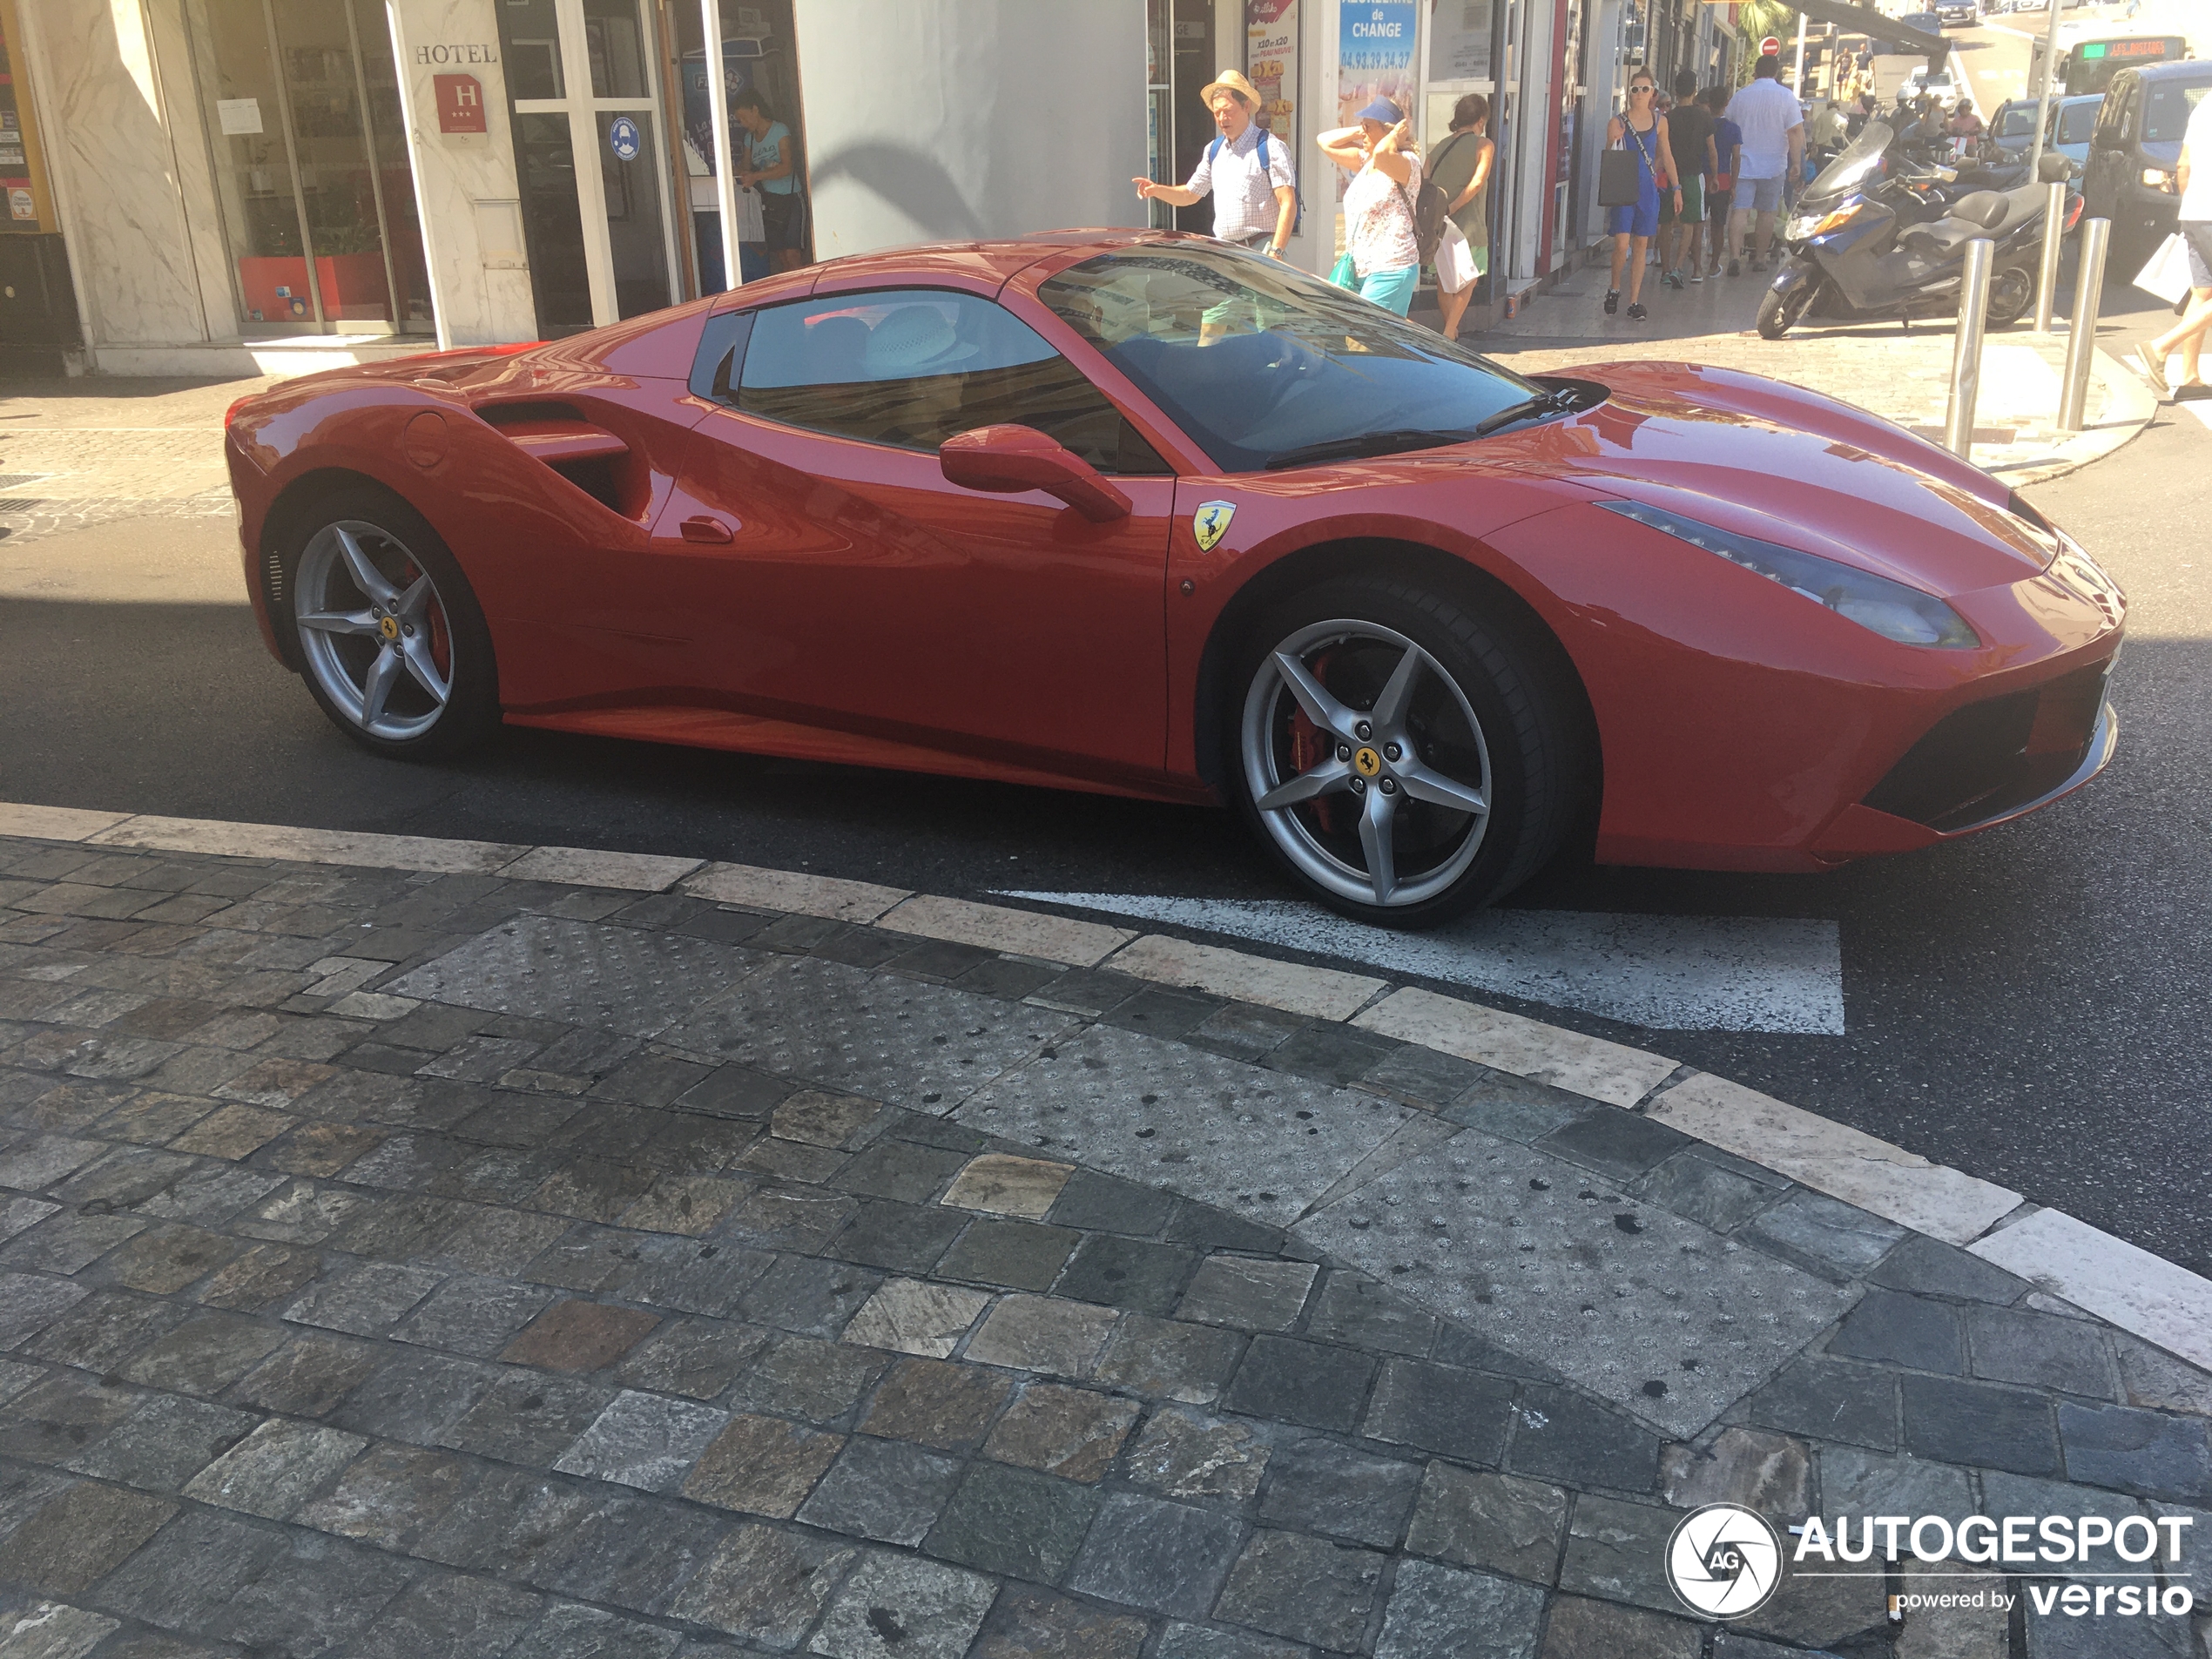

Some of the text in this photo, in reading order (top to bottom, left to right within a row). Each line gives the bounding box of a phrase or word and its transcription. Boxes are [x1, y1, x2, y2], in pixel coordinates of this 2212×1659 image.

[1372, 9, 1384, 21] de
[1352, 22, 1402, 37] CHANGE
[414, 44, 497, 64] HOTEL
[1341, 51, 1411, 70] 04.93.39.34.37
[455, 84, 478, 106] H
